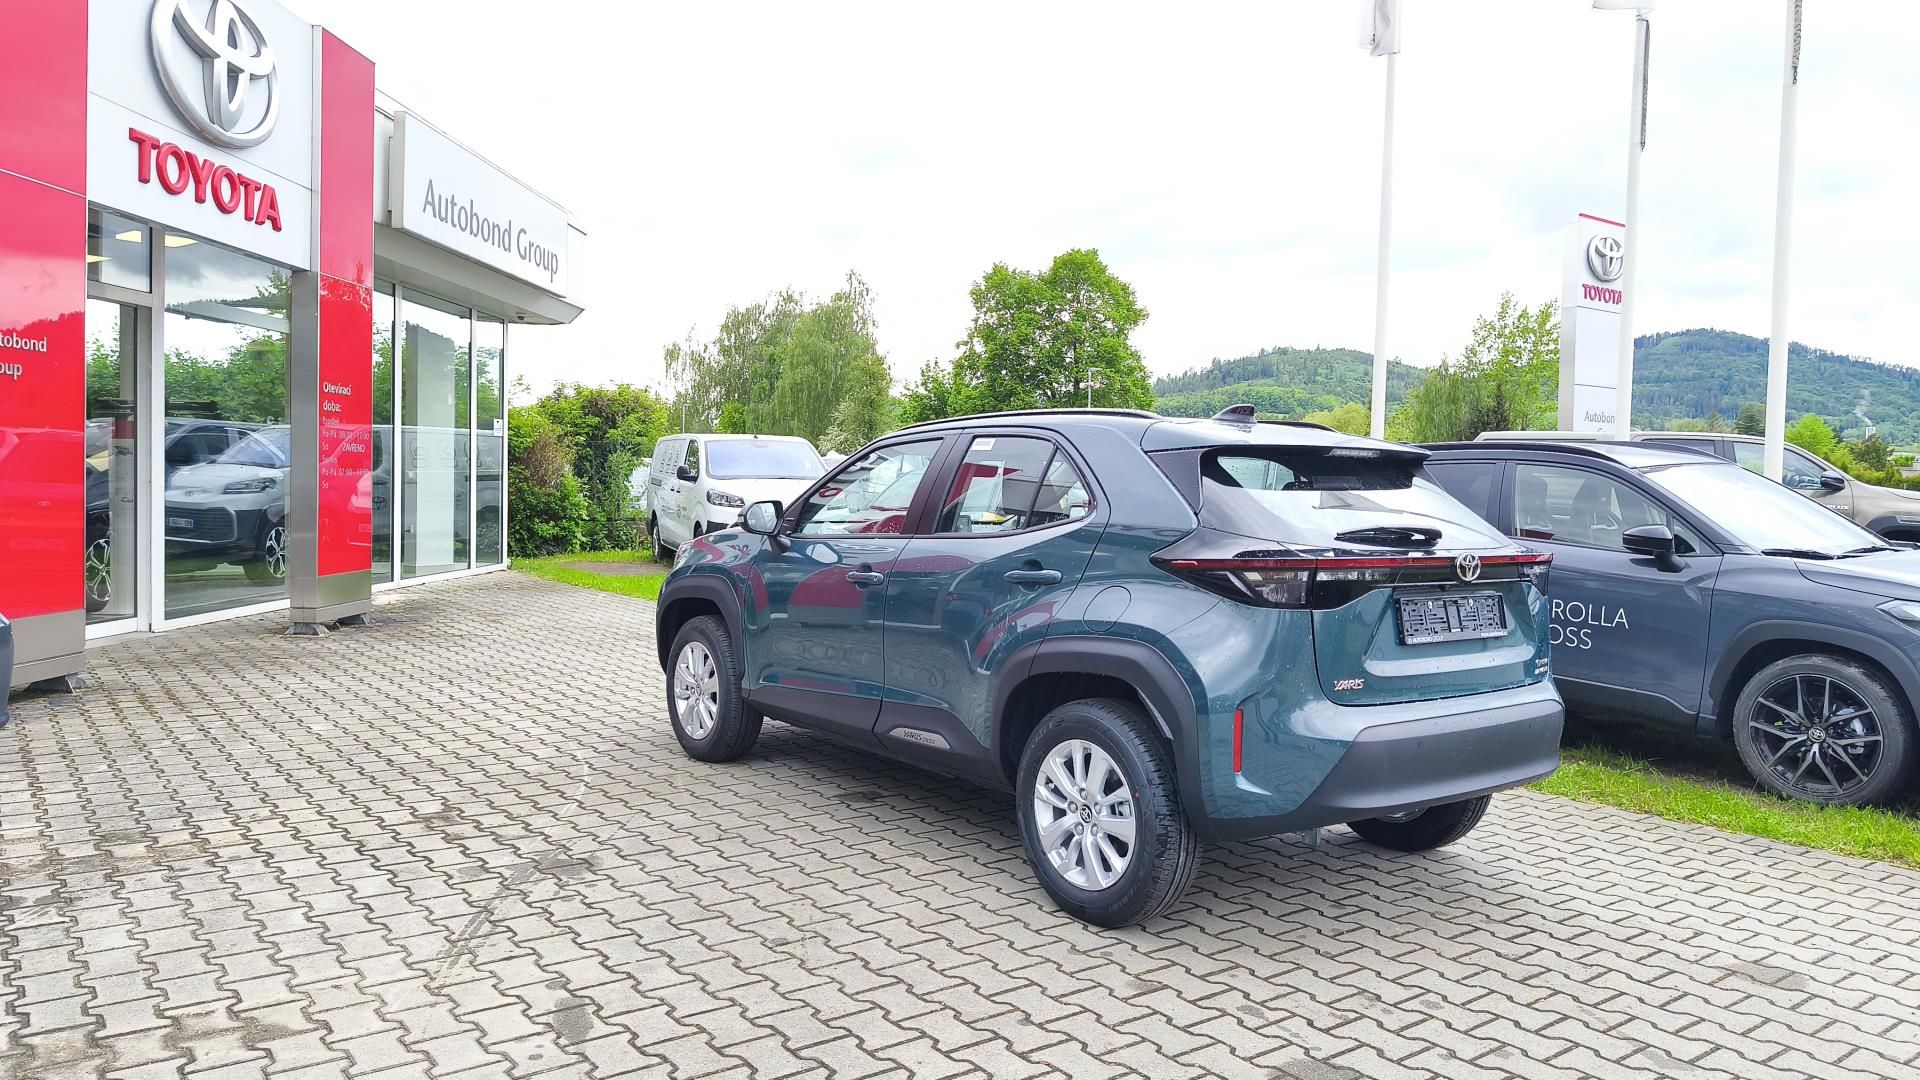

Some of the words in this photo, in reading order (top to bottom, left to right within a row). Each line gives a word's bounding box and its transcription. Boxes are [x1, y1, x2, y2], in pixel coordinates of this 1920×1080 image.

[129, 127, 282, 232] TOYOTA
[422, 178, 512, 254] Autobond
[516, 227, 559, 284] Group
[1582, 283, 1622, 305] TOYOTA
[0, 332, 47, 352] tobond
[0, 361, 23, 380] oup
[323, 400, 342, 412] doba:
[1584, 410, 1616, 424] Autobon
[1552, 599, 1629, 629] ROLLA
[1549, 624, 1592, 650] OSS
[1333, 679, 1365, 691] YARIS
[903, 730, 922, 741] YARIS
